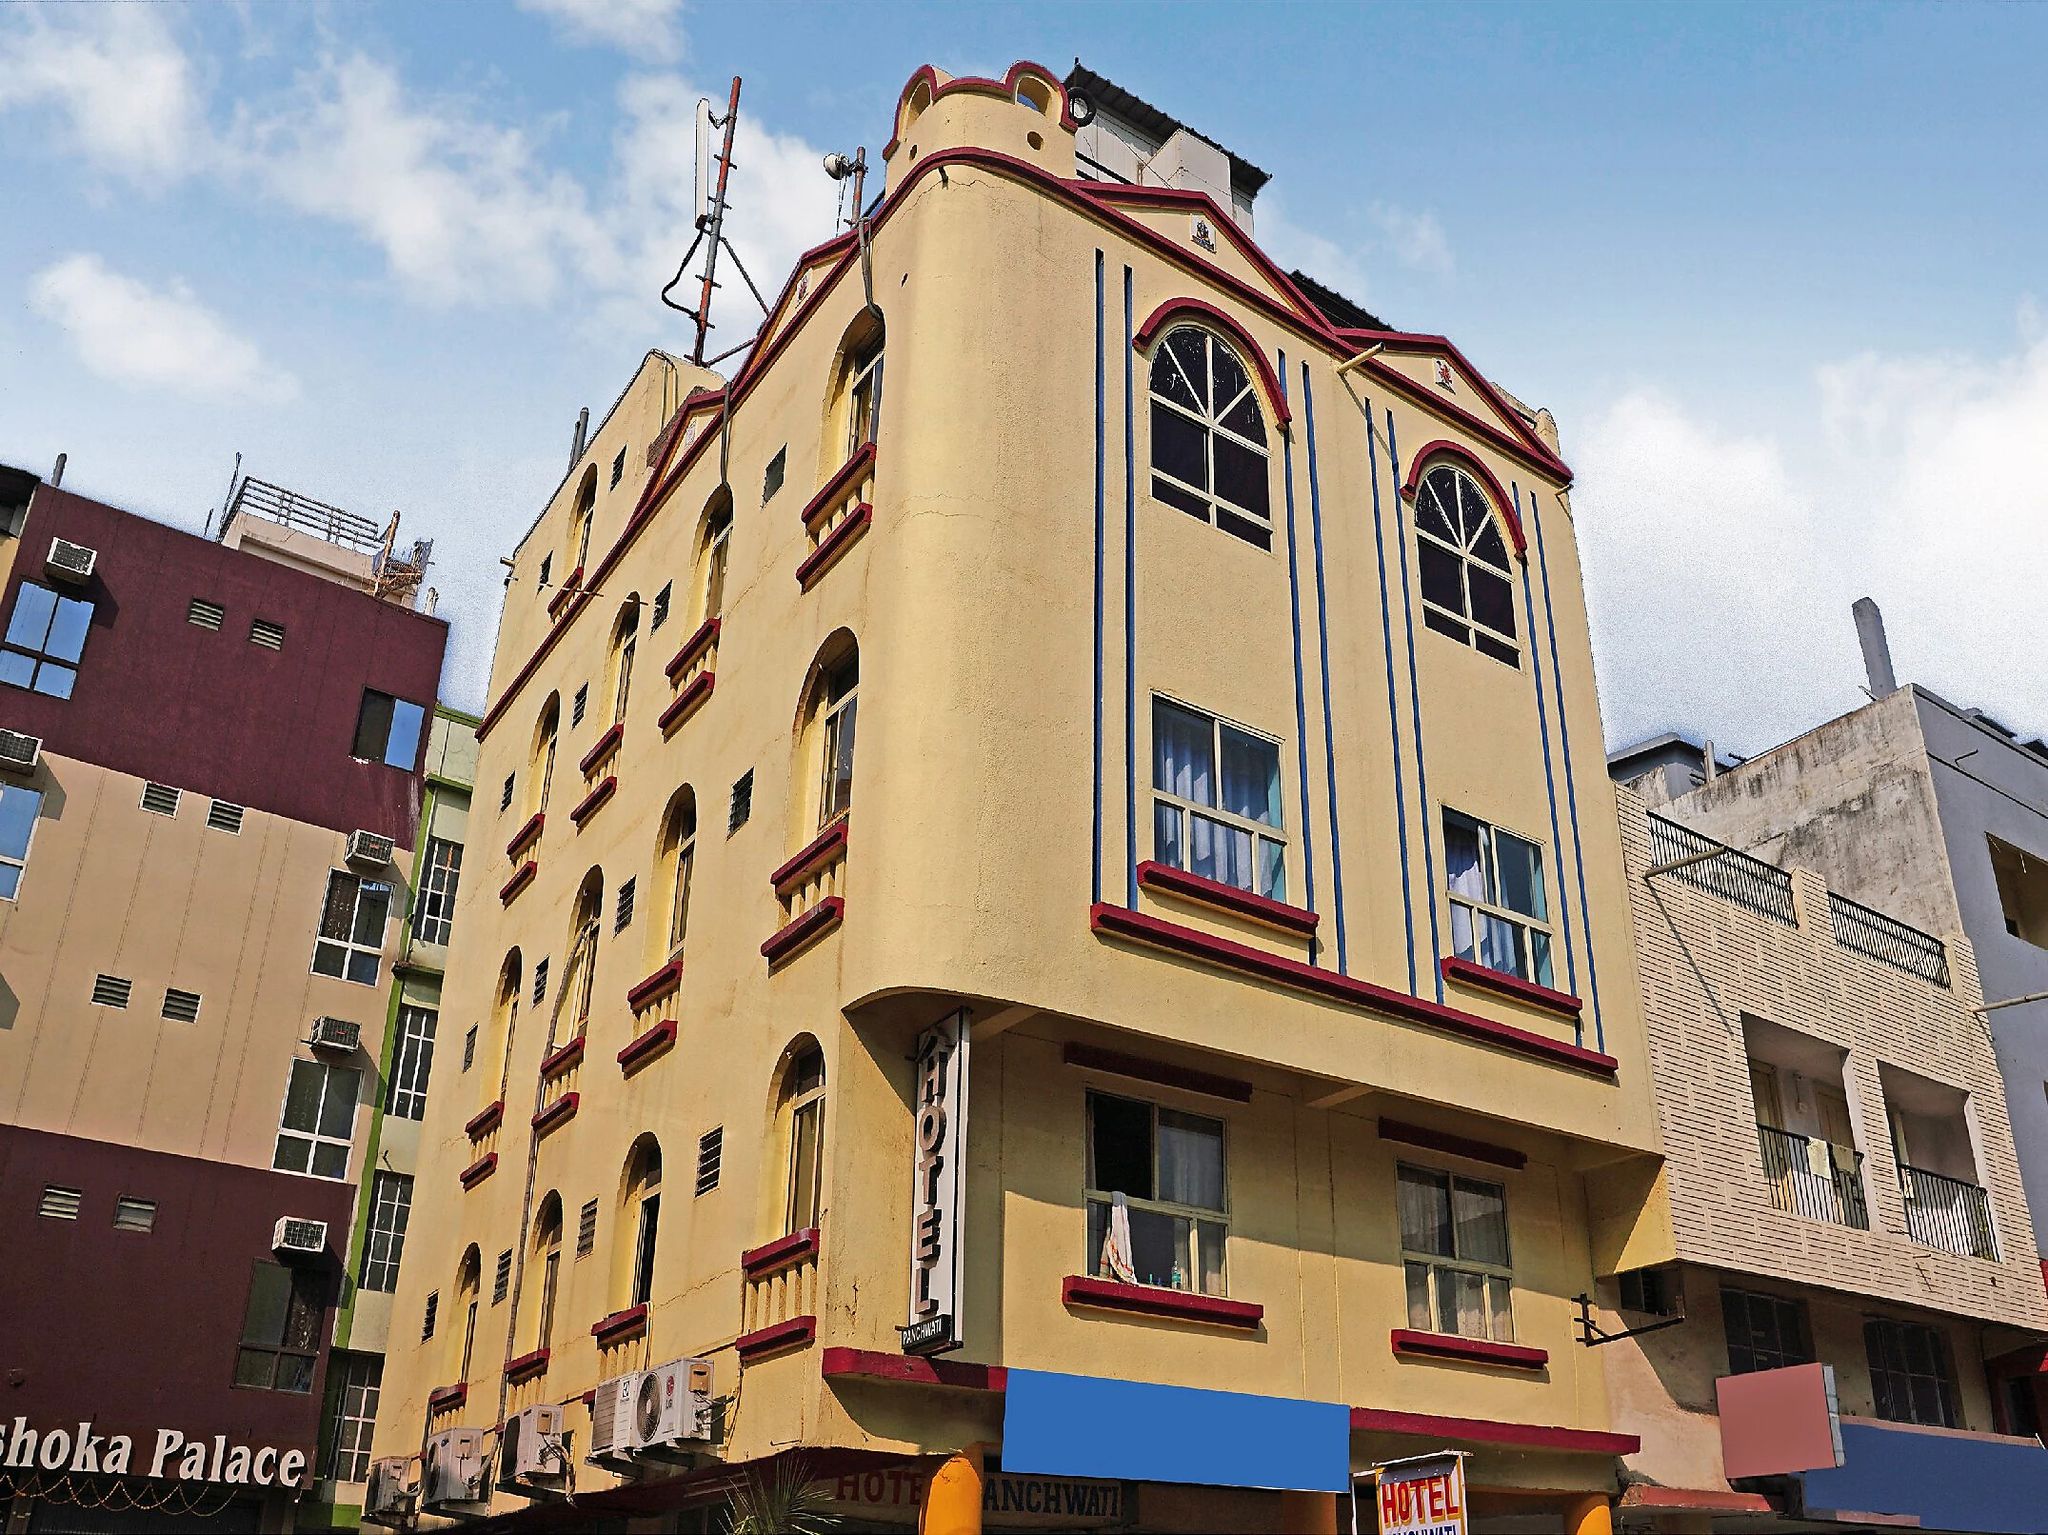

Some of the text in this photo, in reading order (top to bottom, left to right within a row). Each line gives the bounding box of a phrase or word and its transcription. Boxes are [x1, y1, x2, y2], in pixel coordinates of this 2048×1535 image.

[915, 1047, 948, 1316] HOTEL
[902, 1318, 942, 1345] PANCHWATI
[0, 1416, 305, 1488] hoka Palace
[836, 1471, 1120, 1518] HOTE ANCHWATI
[1381, 1474, 1460, 1526] HOTEL
